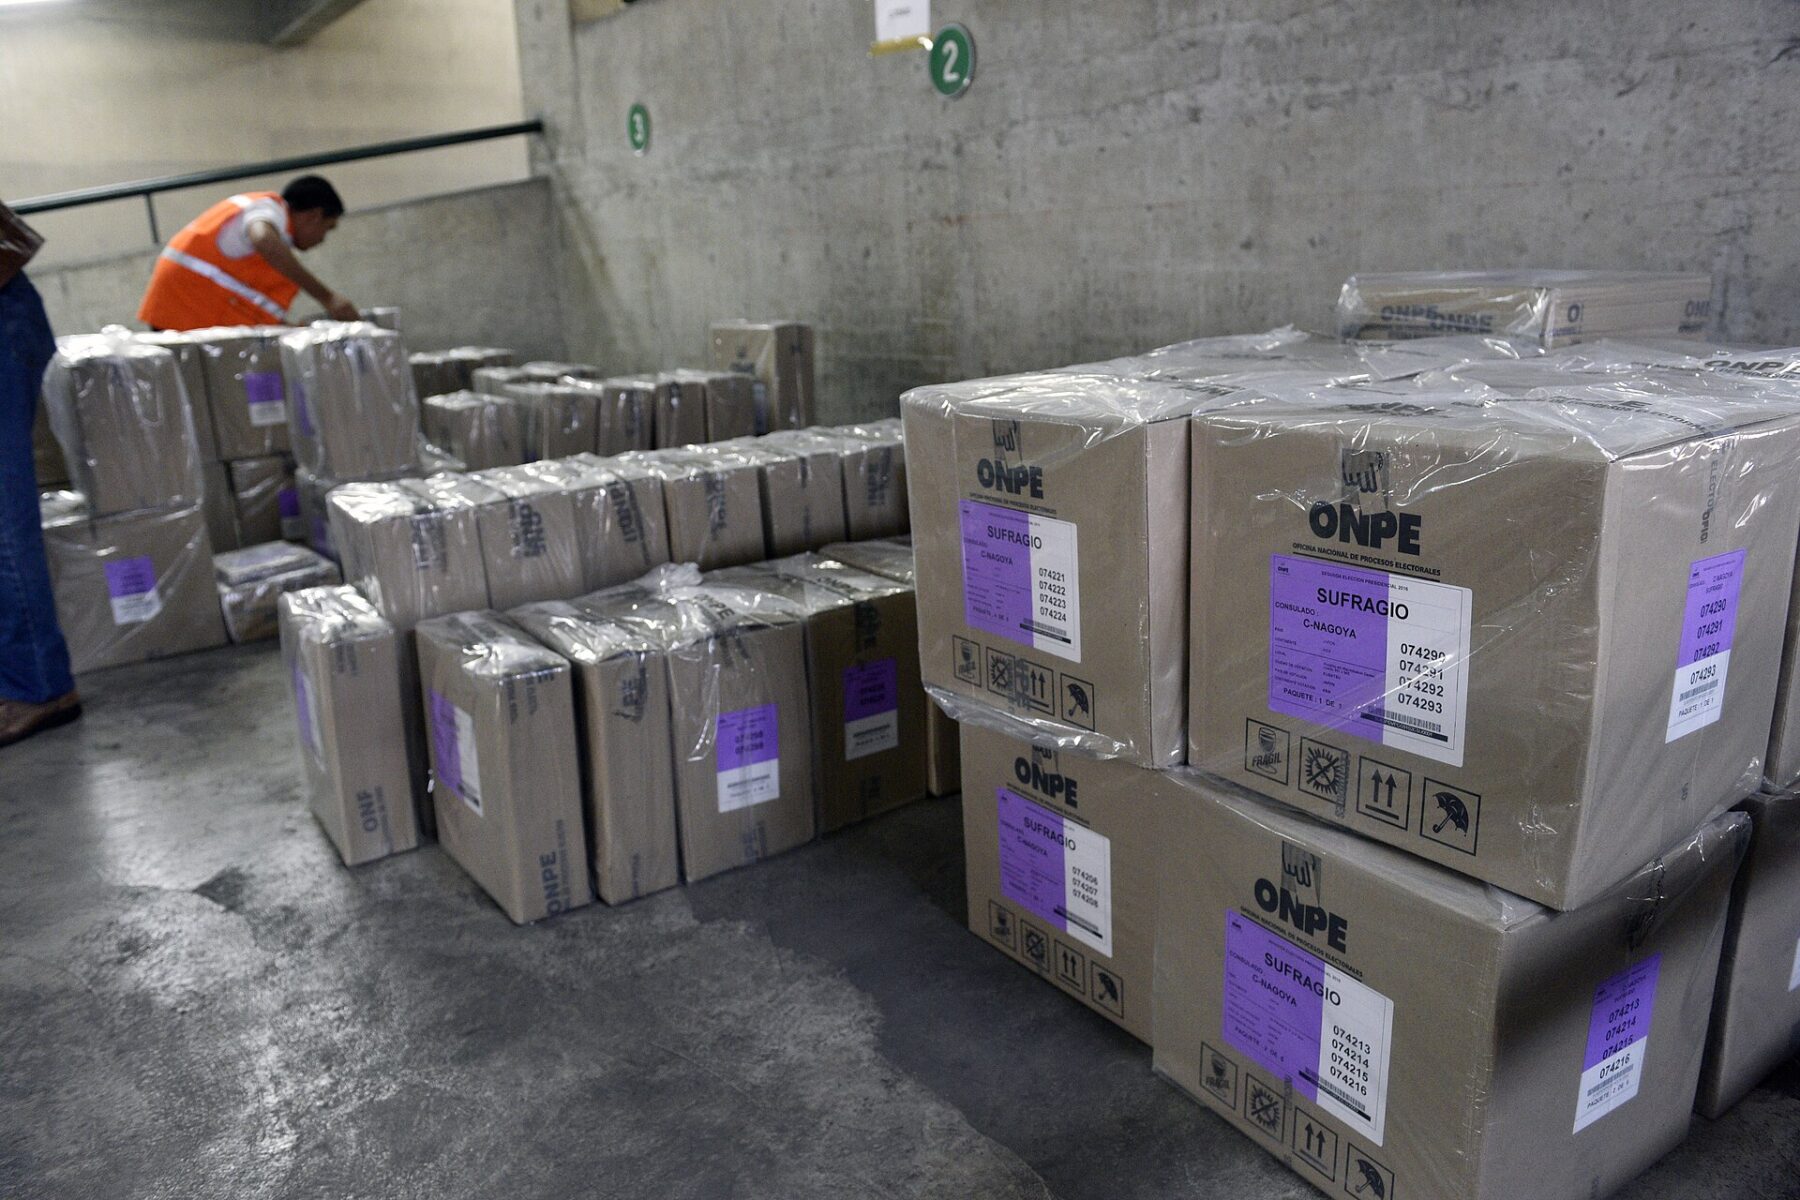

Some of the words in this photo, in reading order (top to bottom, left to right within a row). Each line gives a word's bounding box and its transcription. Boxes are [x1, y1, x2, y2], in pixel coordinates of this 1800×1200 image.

[942, 40, 959, 81] 2
[977, 458, 1044, 500] ONPE
[987, 525, 1042, 550] SUFRAGIO
[1309, 501, 1422, 556] ONPE
[1317, 546, 1349, 559] NACIONAL
[1350, 551, 1359, 561] DE
[1360, 554, 1394, 568] PROCESOS
[1395, 561, 1441, 577] ELECTORALES
[1039, 567, 1065, 582] 074221
[1039, 580, 1066, 596] 074222
[1040, 594, 1066, 609] 074223
[1040, 606, 1067, 622] 074224
[1275, 601, 1315, 616] CONSULADO
[1317, 587, 1409, 621] SUFRAGIO
[1700, 599, 1727, 618] 074290
[1303, 618, 1357, 639] C-NAGOYA
[1697, 619, 1723, 639] 074291
[1401, 643, 1446, 663] 074290
[1694, 642, 1720, 662] 074292
[1400, 660, 1443, 680] 074291
[1690, 664, 1716, 685] 074293
[1283, 687, 1313, 701] PAQUETE
[1326, 699, 1335, 708] DE
[1399, 676, 1444, 697] 074292
[1398, 693, 1442, 714] 074293
[1252, 753, 1282, 767] FRAGIL
[1014, 757, 1078, 809] ONPE
[1024, 817, 1076, 851] SUFRAGIO
[1254, 878, 1348, 954] ONPE
[1252, 974, 1297, 1008] C-NAGOYA
[1264, 952, 1341, 1006] SUFRAGIO
[1609, 998, 1640, 1023] 074213
[1333, 1025, 1371, 1055] 074213
[1606, 1016, 1636, 1041] 074214
[1332, 1039, 1369, 1068] 074214
[1603, 1035, 1634, 1060] 074215
[1331, 1052, 1368, 1082] 074215
[1599, 1054, 1630, 1079] 074216
[1330, 1066, 1367, 1096] 074216
